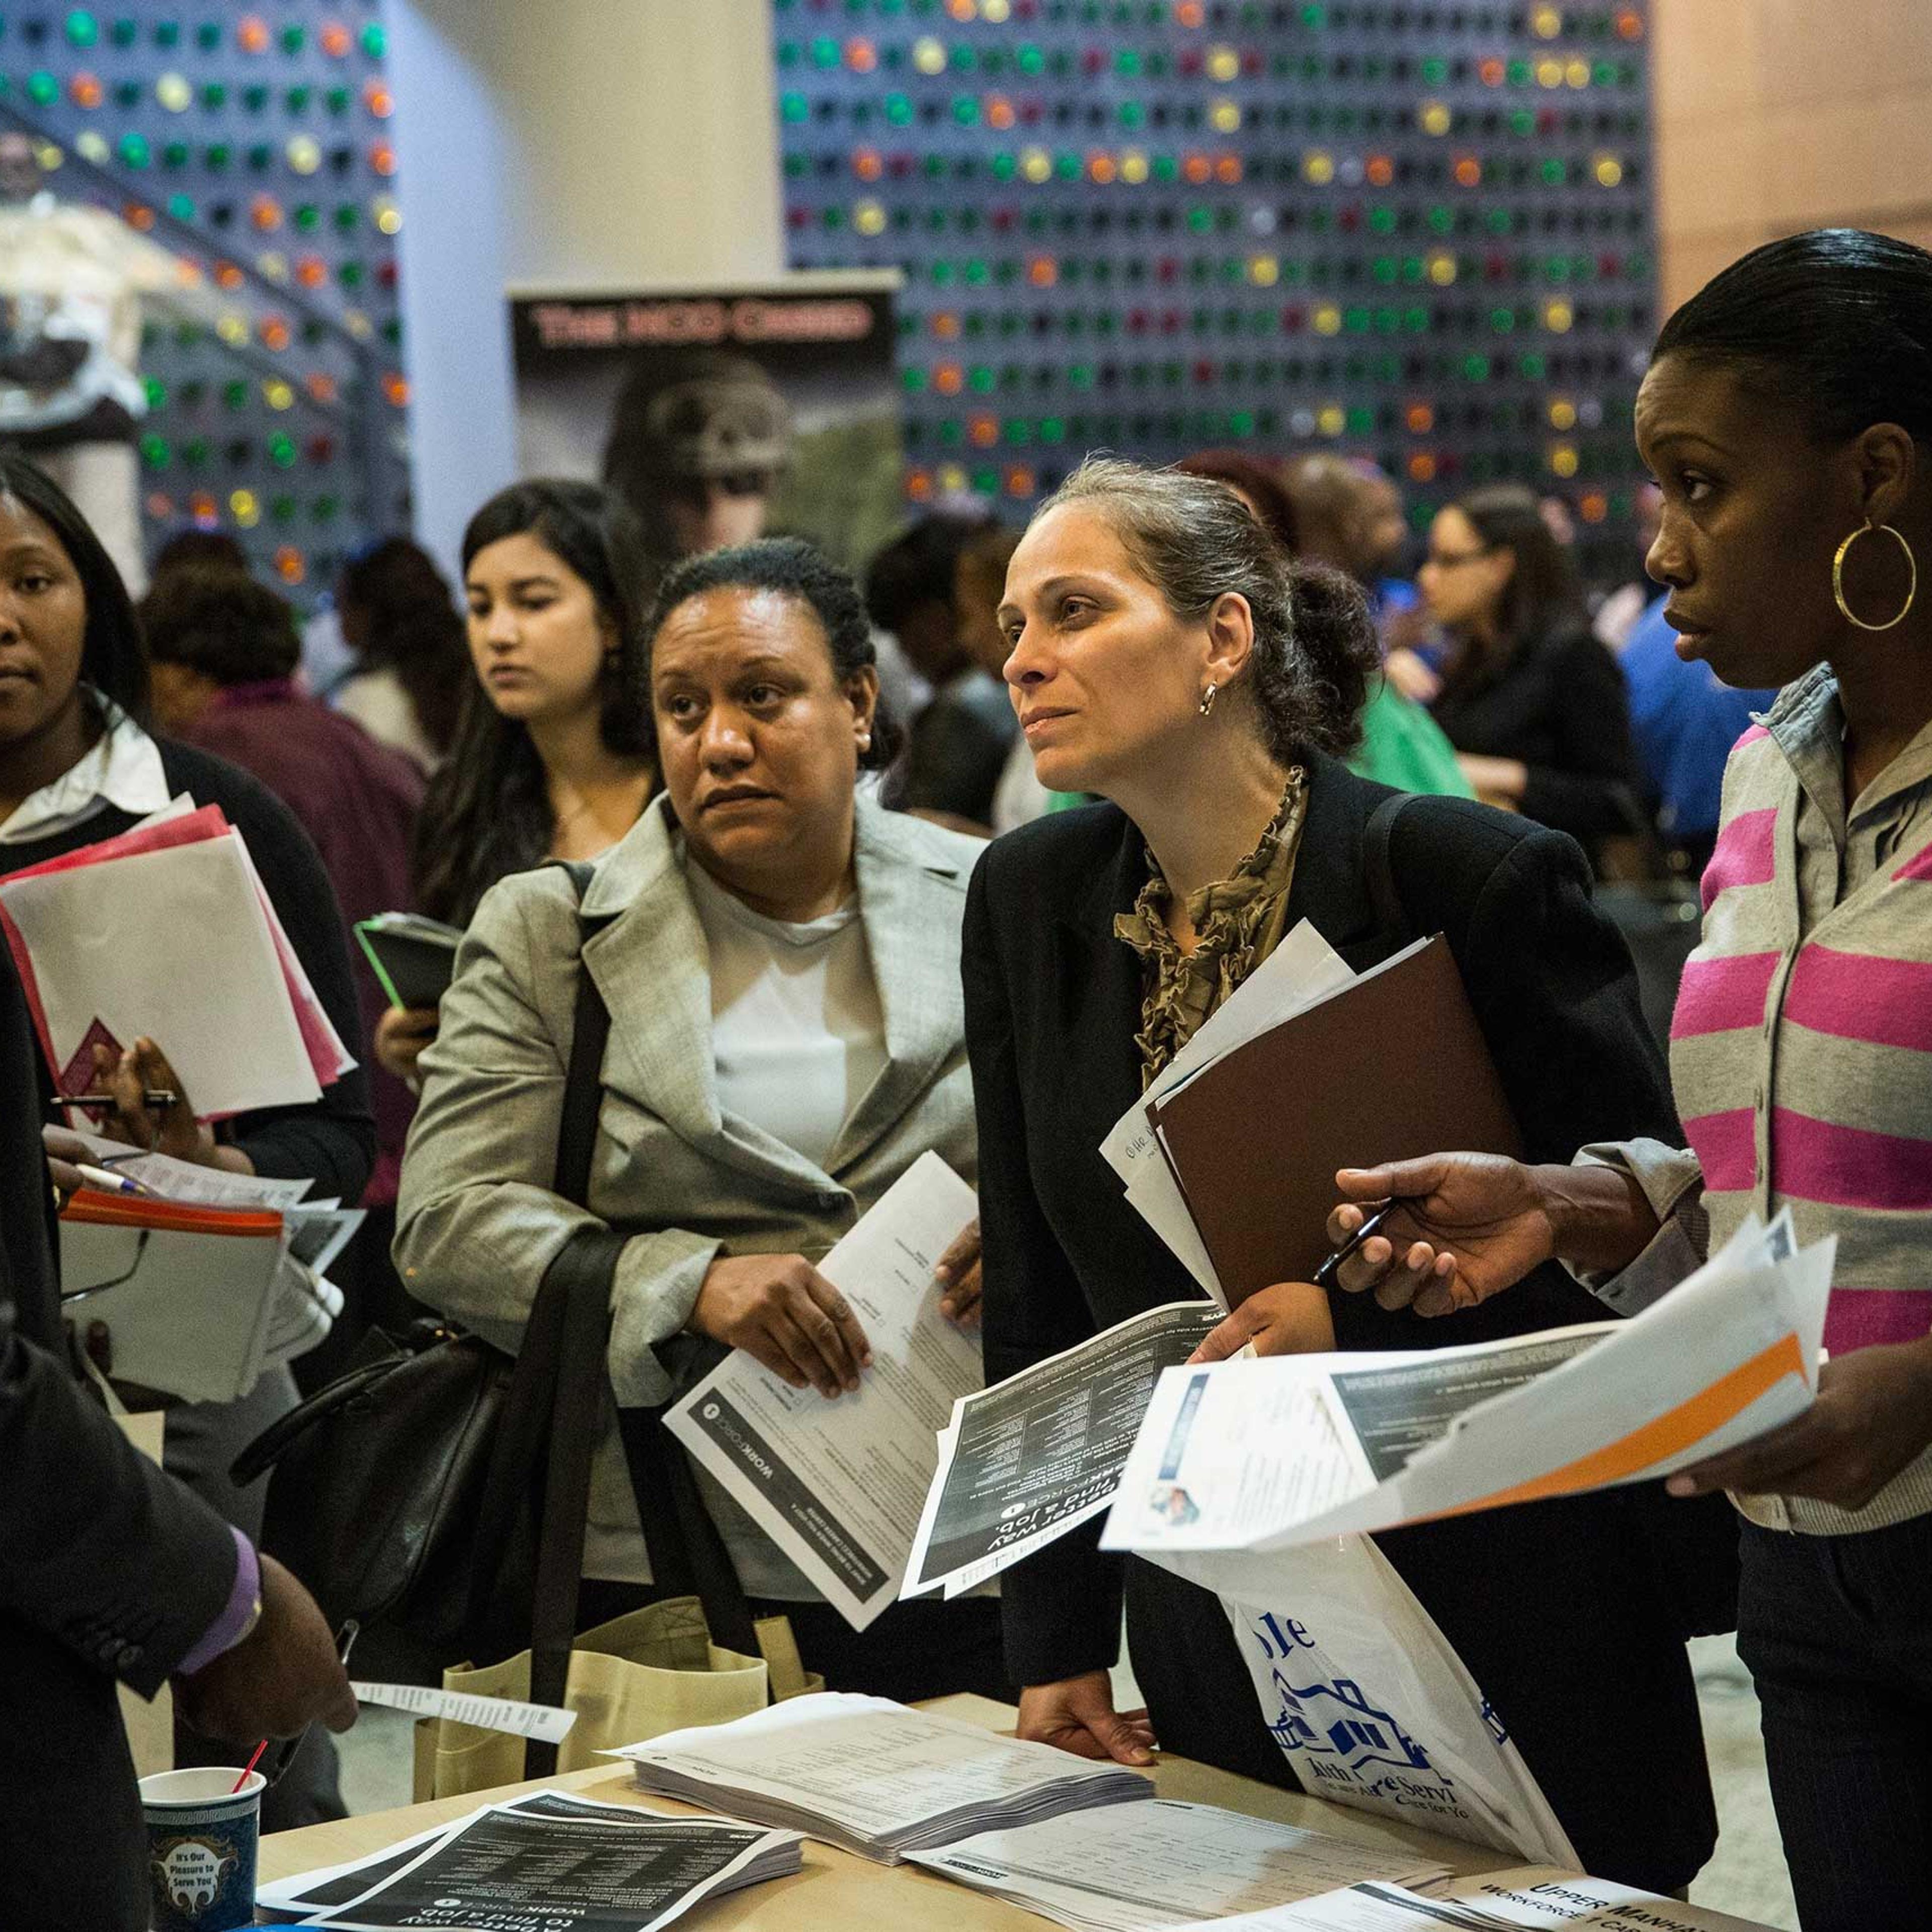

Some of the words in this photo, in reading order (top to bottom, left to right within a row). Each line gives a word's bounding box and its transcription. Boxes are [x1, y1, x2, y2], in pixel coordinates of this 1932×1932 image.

[988, 1524, 1037, 1550] way
[190, 1853, 205, 1862] Our
[170, 1865, 203, 1875] Pleasure
[206, 1865, 214, 1873] to
[174, 1877, 195, 1887] Serve
[1530, 1883, 1609, 1909] UPPER
[1480, 1884, 1585, 1920] WORKFORCE
[397, 1916, 451, 1924] way
[486, 1913, 539, 1924] find
[546, 1918, 573, 1927] to
